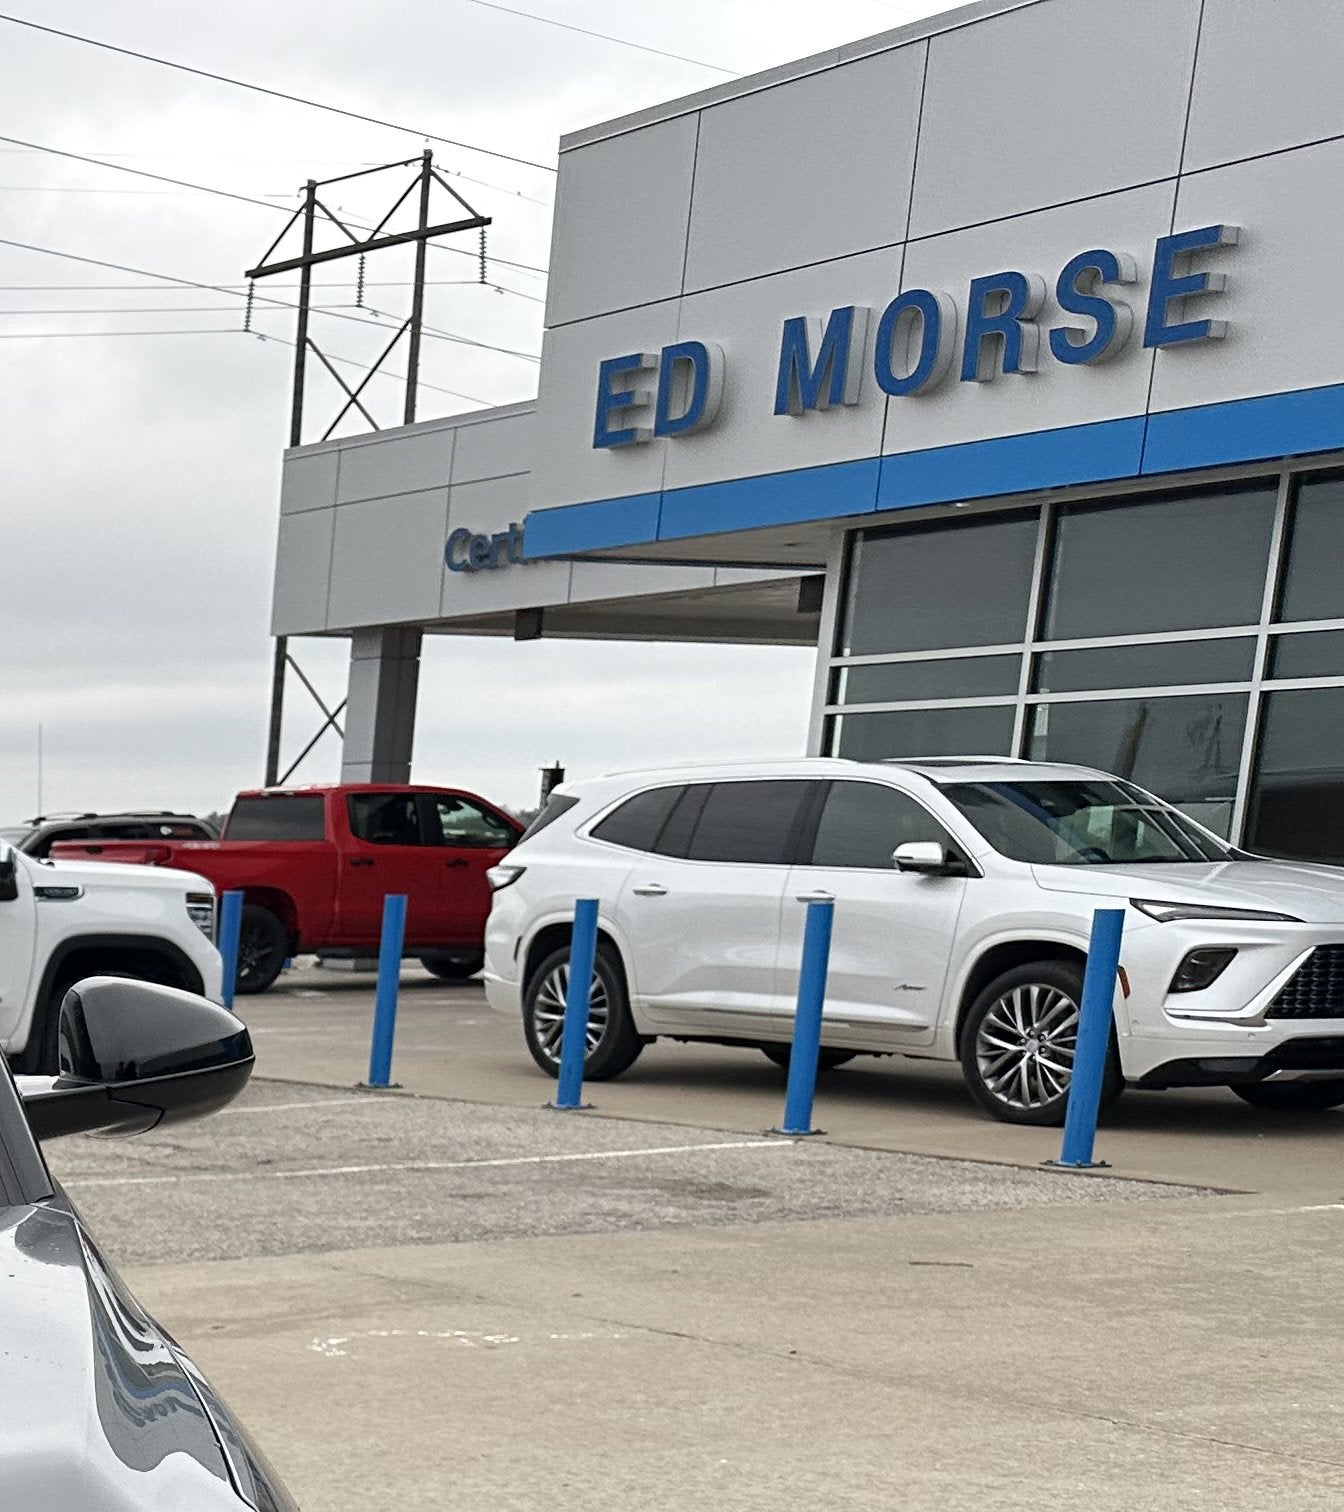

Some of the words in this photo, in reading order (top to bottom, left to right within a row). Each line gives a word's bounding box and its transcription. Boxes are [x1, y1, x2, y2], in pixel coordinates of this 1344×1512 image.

[593, 341, 716, 448] ED
[773, 224, 1230, 417] MORSE
[445, 515, 528, 571] Cert
